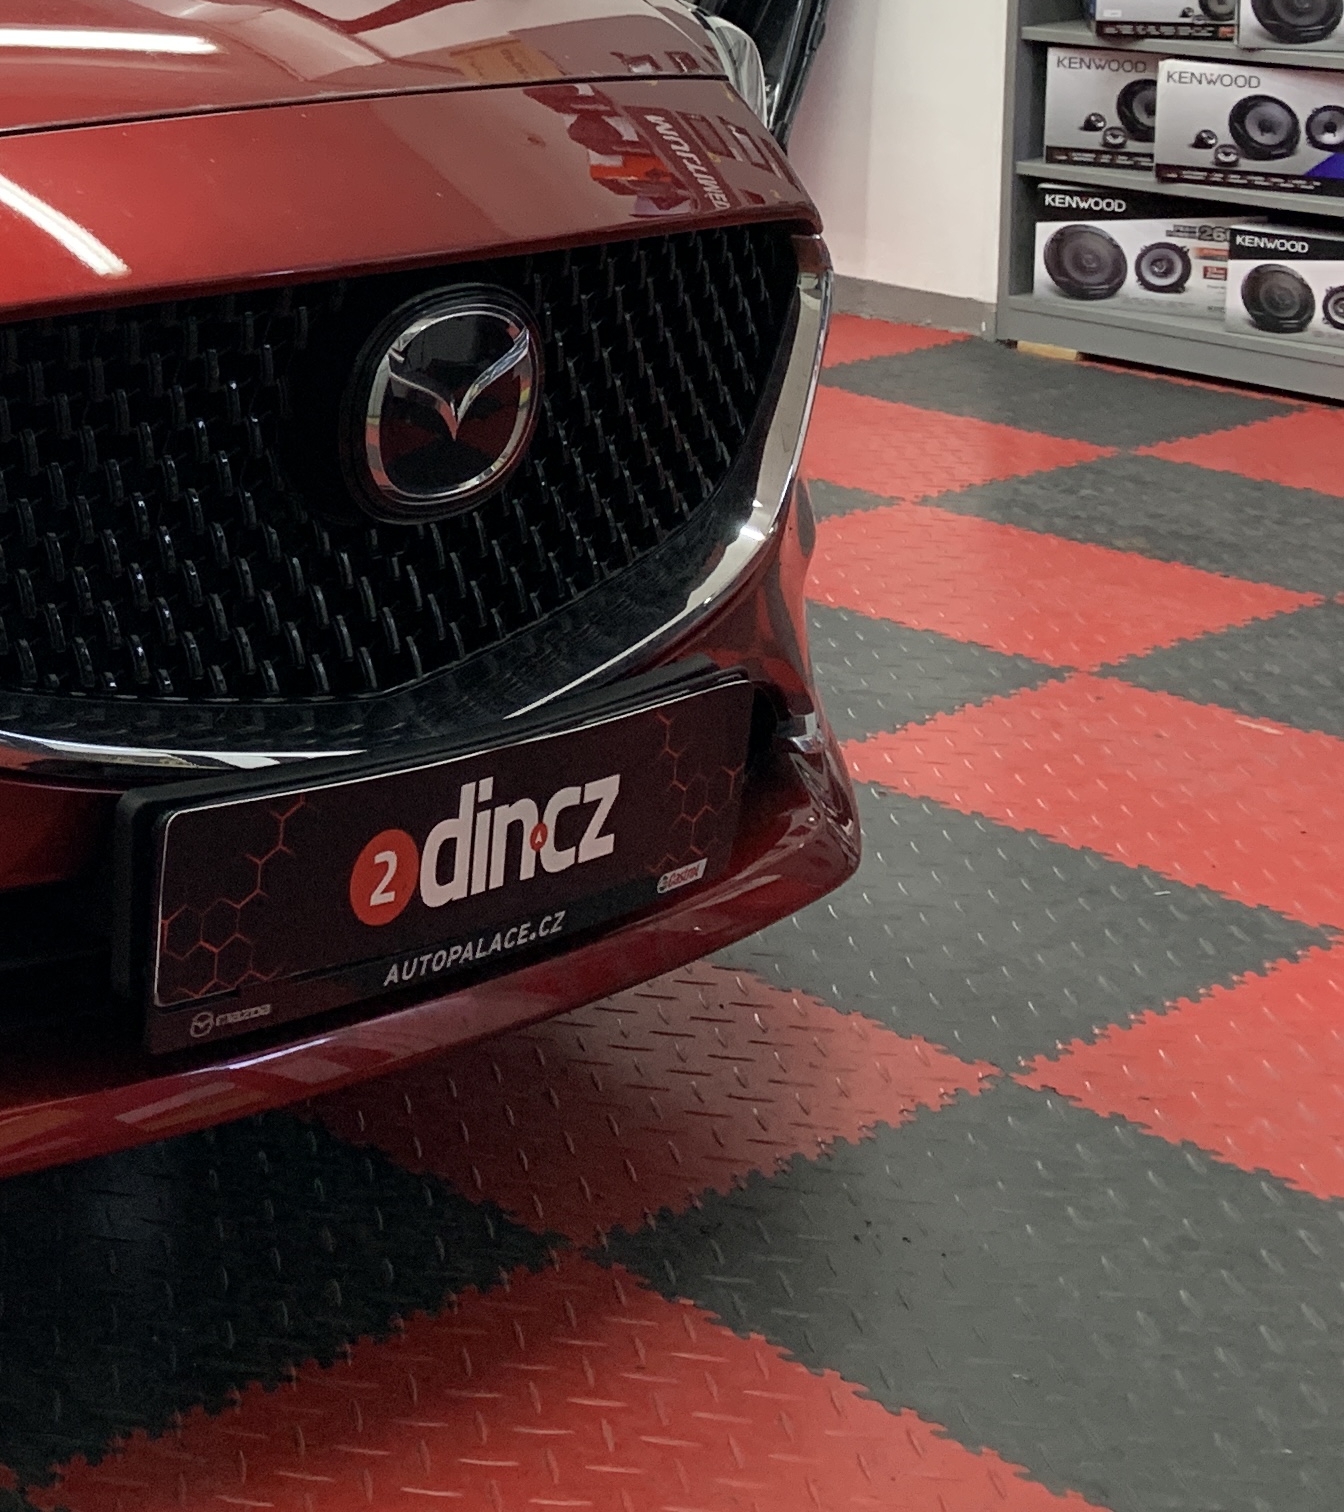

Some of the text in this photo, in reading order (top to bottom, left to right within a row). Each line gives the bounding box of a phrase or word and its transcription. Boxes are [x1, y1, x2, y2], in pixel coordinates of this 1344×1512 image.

[1056, 56, 1147, 73] KENWOOD
[1167, 70, 1261, 89] KENWOOD
[1044, 193, 1127, 212] KENWOOD
[1198, 225, 1230, 242] 26
[1235, 234, 1310, 254] KENWOOD
[384, 911, 566, 987] AUTOPALACE.CZ
